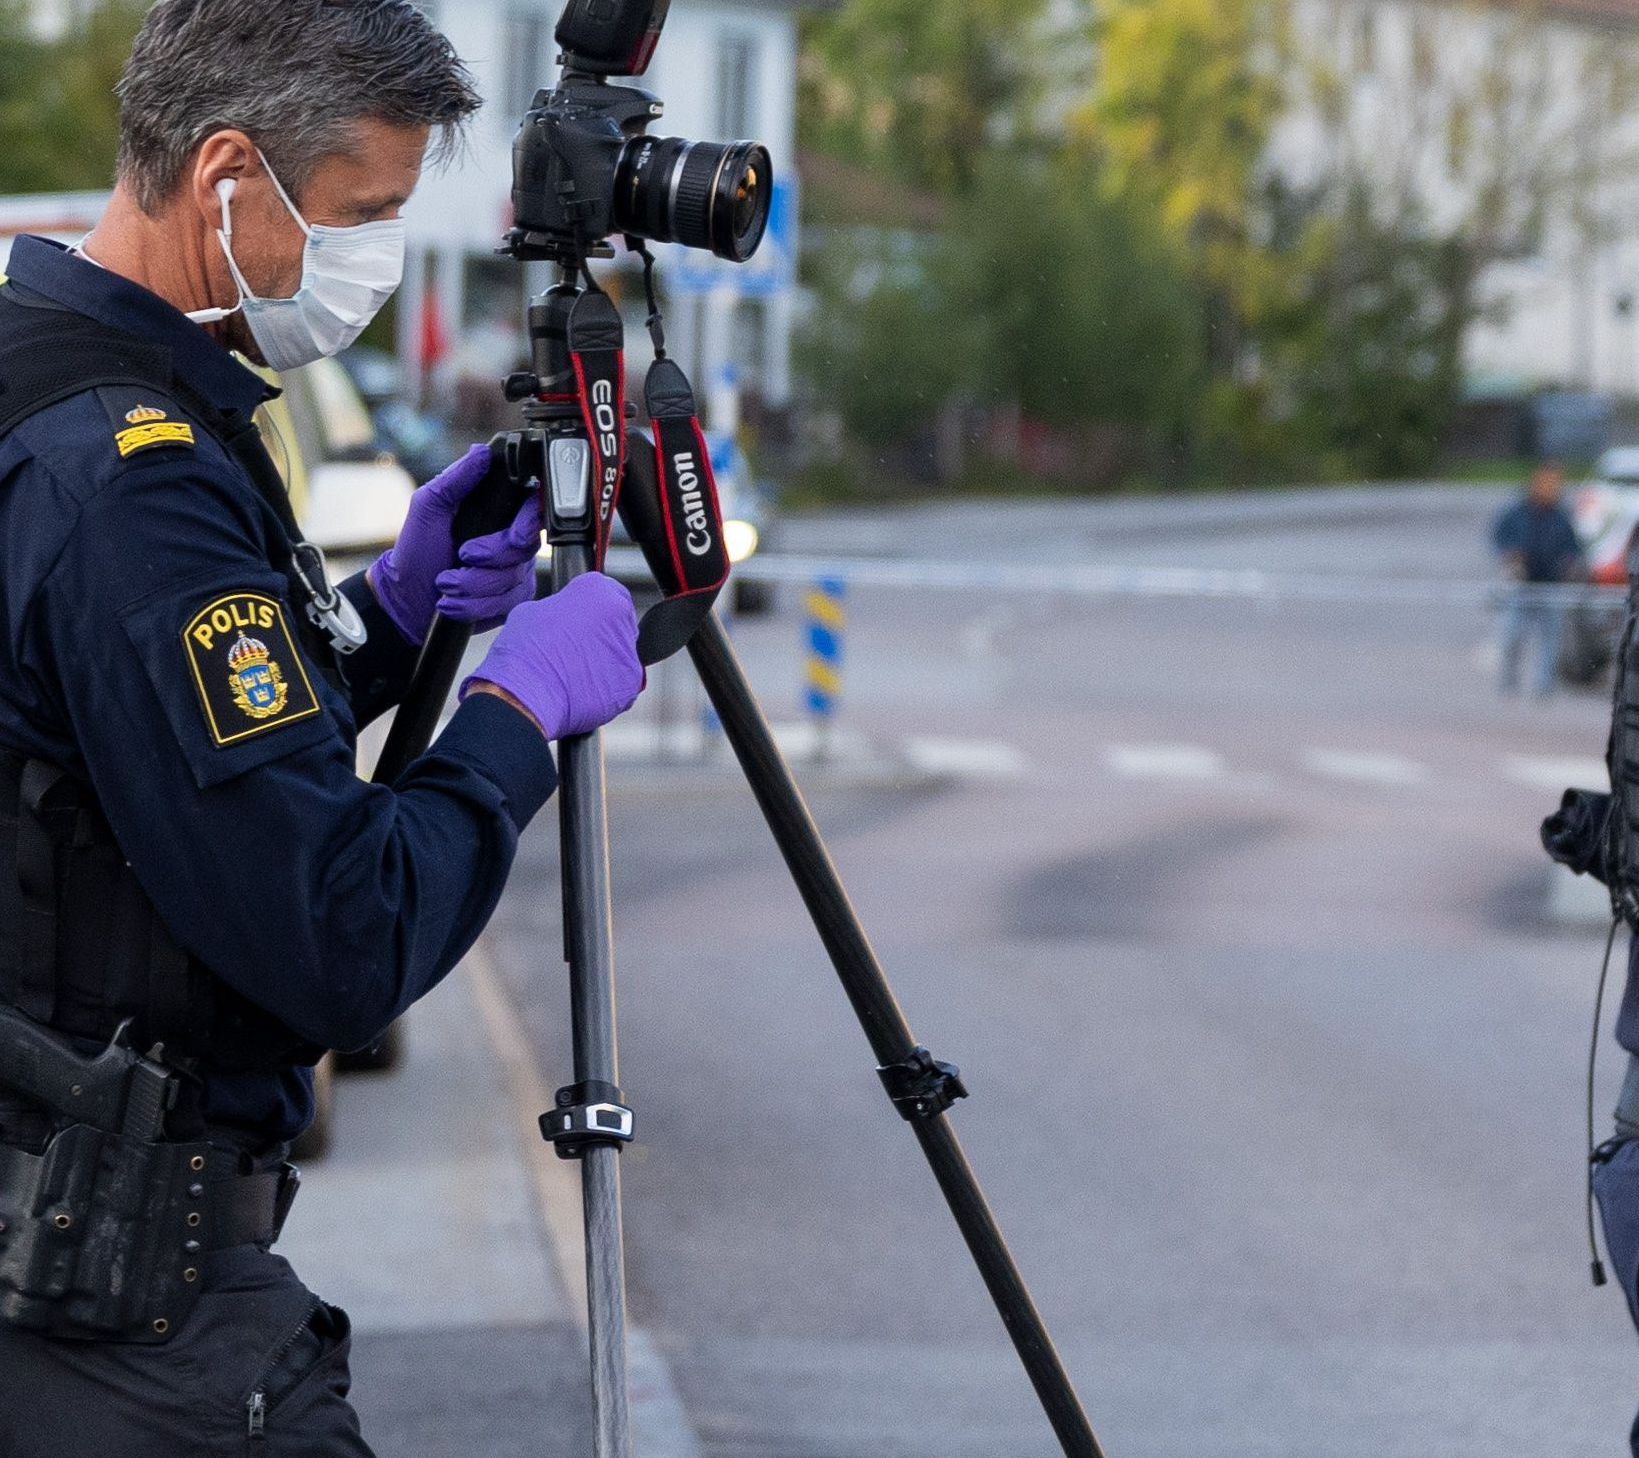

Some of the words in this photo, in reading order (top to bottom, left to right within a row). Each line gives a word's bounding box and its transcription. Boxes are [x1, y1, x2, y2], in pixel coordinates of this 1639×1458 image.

[592, 379, 617, 458] EOS
[600, 467, 617, 522] 80D
[673, 451, 712, 556] Canon
[192, 601, 275, 650] POLIS
